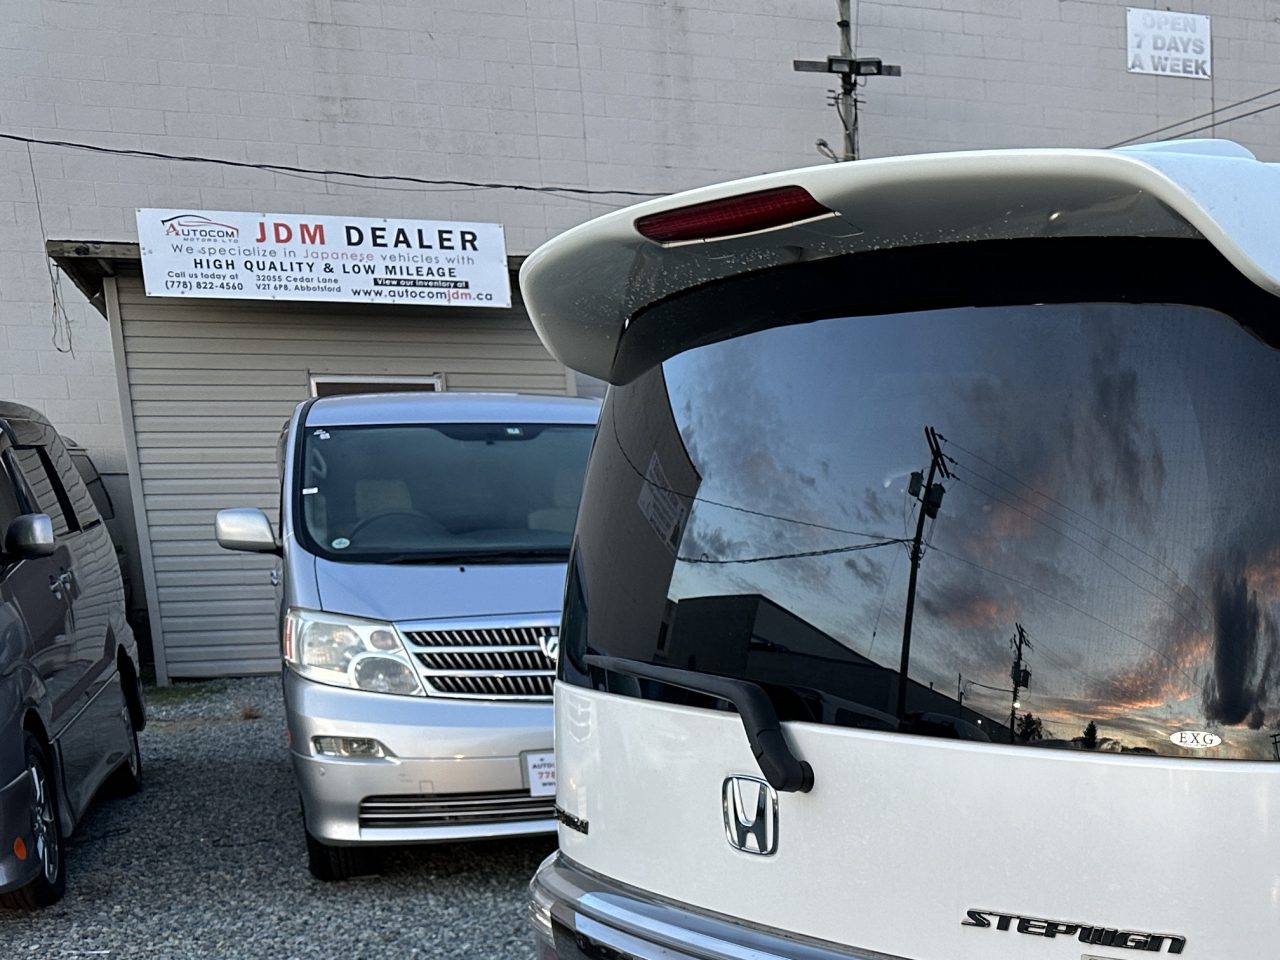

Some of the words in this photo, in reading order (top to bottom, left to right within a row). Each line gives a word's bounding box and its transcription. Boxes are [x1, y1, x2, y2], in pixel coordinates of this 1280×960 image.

[1142, 13, 1197, 33] OPEN
[1134, 34, 1144, 49] 7
[1152, 34, 1205, 55] DAYS
[1131, 53, 1145, 70] A
[1150, 55, 1208, 76] WEEK
[256, 222, 326, 245] JDM
[345, 225, 479, 251] DEALER
[172, 244, 194, 254] We
[201, 246, 277, 257] specialize
[284, 248, 296, 258] in
[304, 249, 374, 261] Japanese
[380, 252, 439, 264] vehicles
[446, 254, 475, 265] with
[167, 271, 186, 279] Call
[201, 272, 226, 280] today
[194, 258, 235, 270] HIGH
[244, 260, 314, 273] QUALITY
[323, 263, 335, 274] &
[342, 263, 376, 275] LOW
[385, 265, 457, 278] MILEAGE
[165, 280, 193, 290] (778)
[196, 281, 244, 291] 822-4560
[256, 274, 283, 282] 32055
[285, 275, 314, 283] Cedar
[375, 278, 398, 286] View
[415, 280, 454, 289] inventory
[255, 283, 271, 291] V2T
[294, 285, 341, 293] Abbotsford
[351, 287, 493, 303] www.autocomjdm.ca
[1180, 732, 1213, 745] EXG
